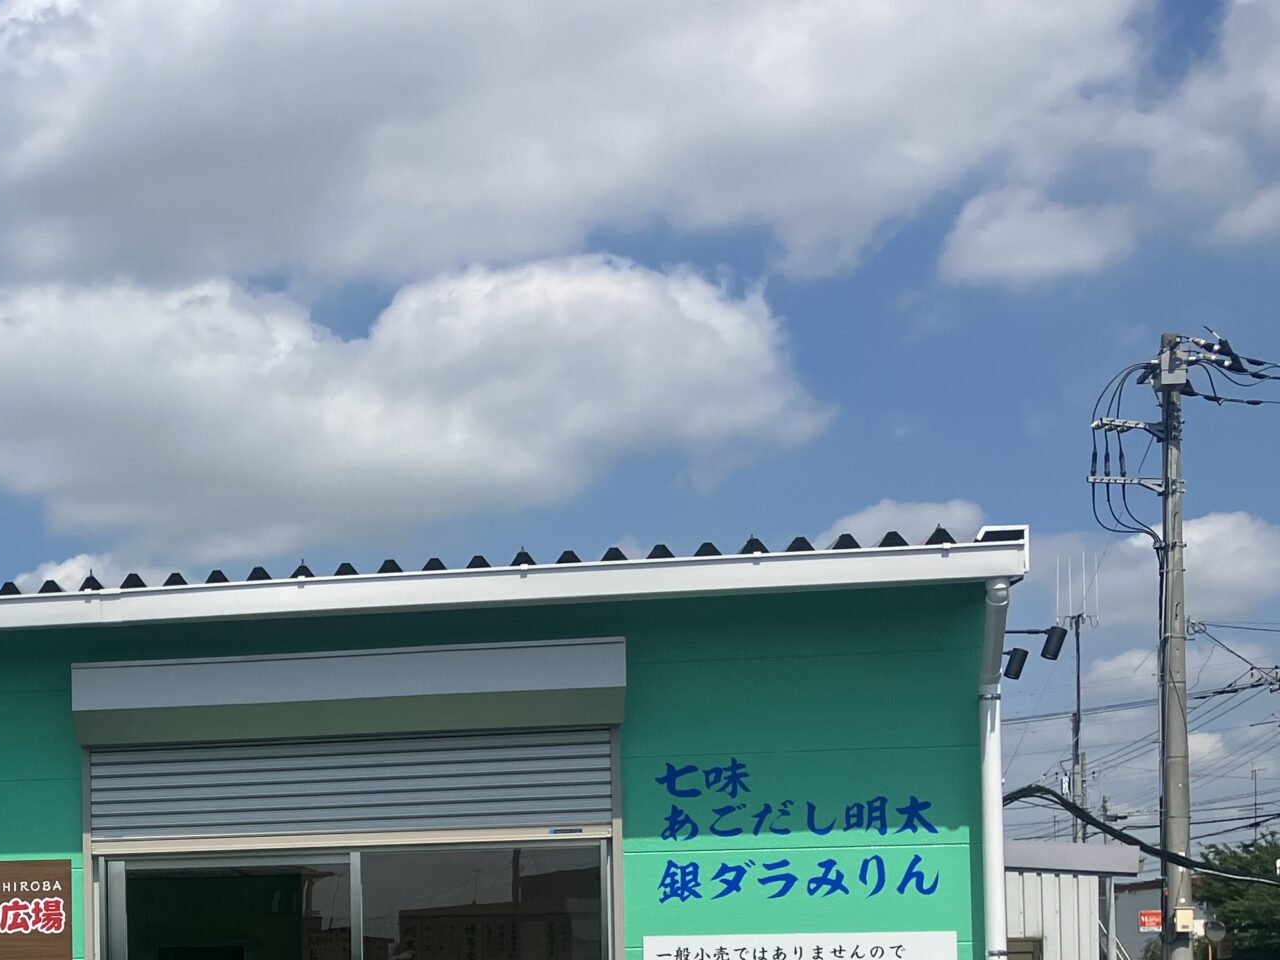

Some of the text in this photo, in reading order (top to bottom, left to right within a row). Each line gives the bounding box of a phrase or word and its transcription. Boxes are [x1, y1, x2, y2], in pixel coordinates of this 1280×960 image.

[654, 757, 752, 798] 七味
[660, 796, 939, 842] あごだし明太
[3, 880, 62, 892] HIROBA
[658, 854, 940, 904] 銀ダラみりん
